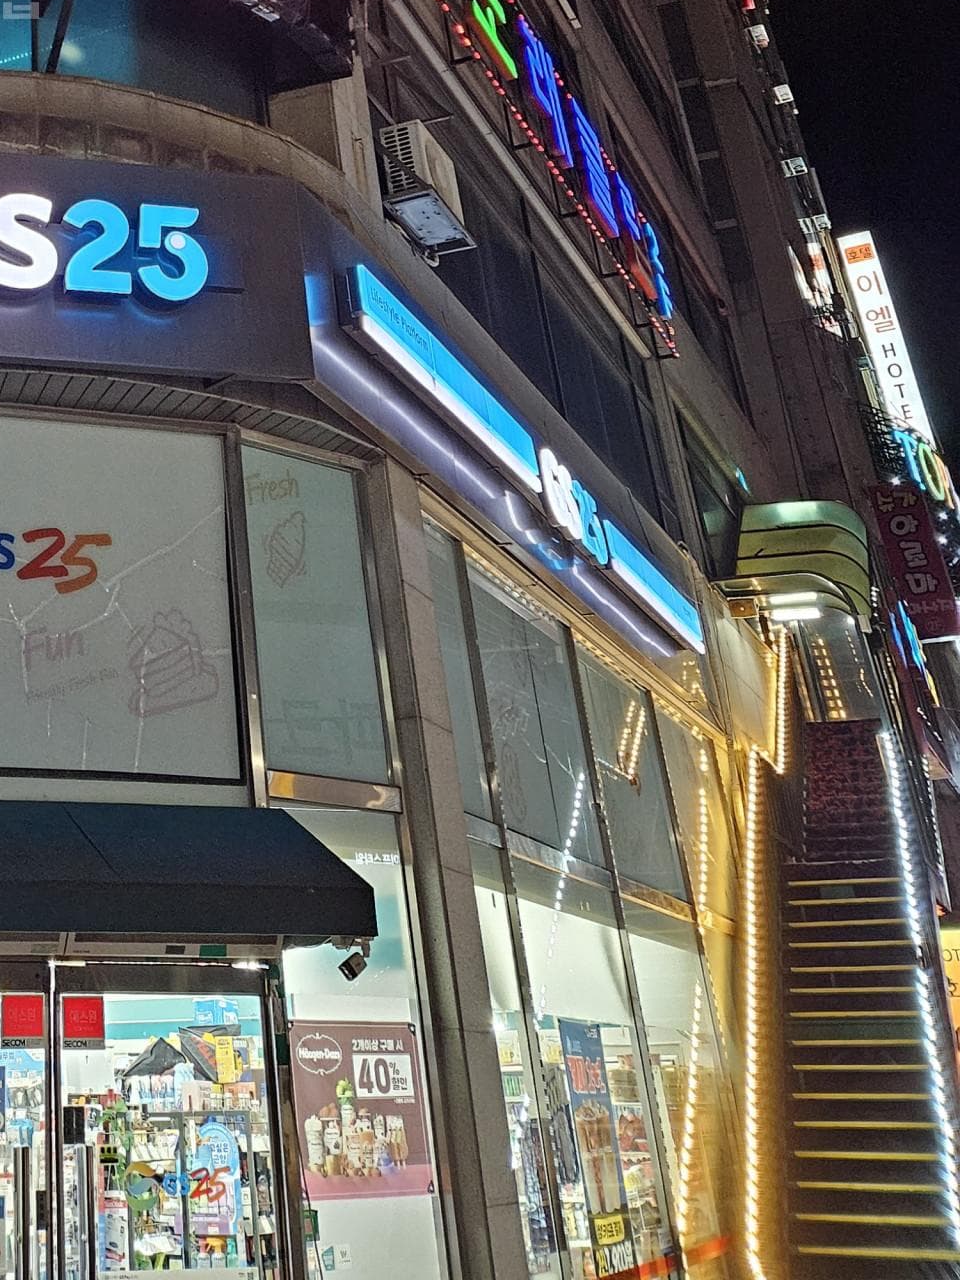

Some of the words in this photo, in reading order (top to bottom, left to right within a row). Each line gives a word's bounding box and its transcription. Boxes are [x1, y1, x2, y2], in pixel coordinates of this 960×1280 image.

[856, 270, 897, 334] 이엘
[881, 341, 914, 420] HOTE
[246, 468, 300, 505] Fresh
[540, 447, 609, 565] GS25
[890, 513, 939, 595] 아로마
[22, 628, 88, 673] Fun
[2, 1039, 26, 1048] SECOM
[64, 1040, 87, 1048] SECOM
[163, 1166, 231, 1203] GS25
